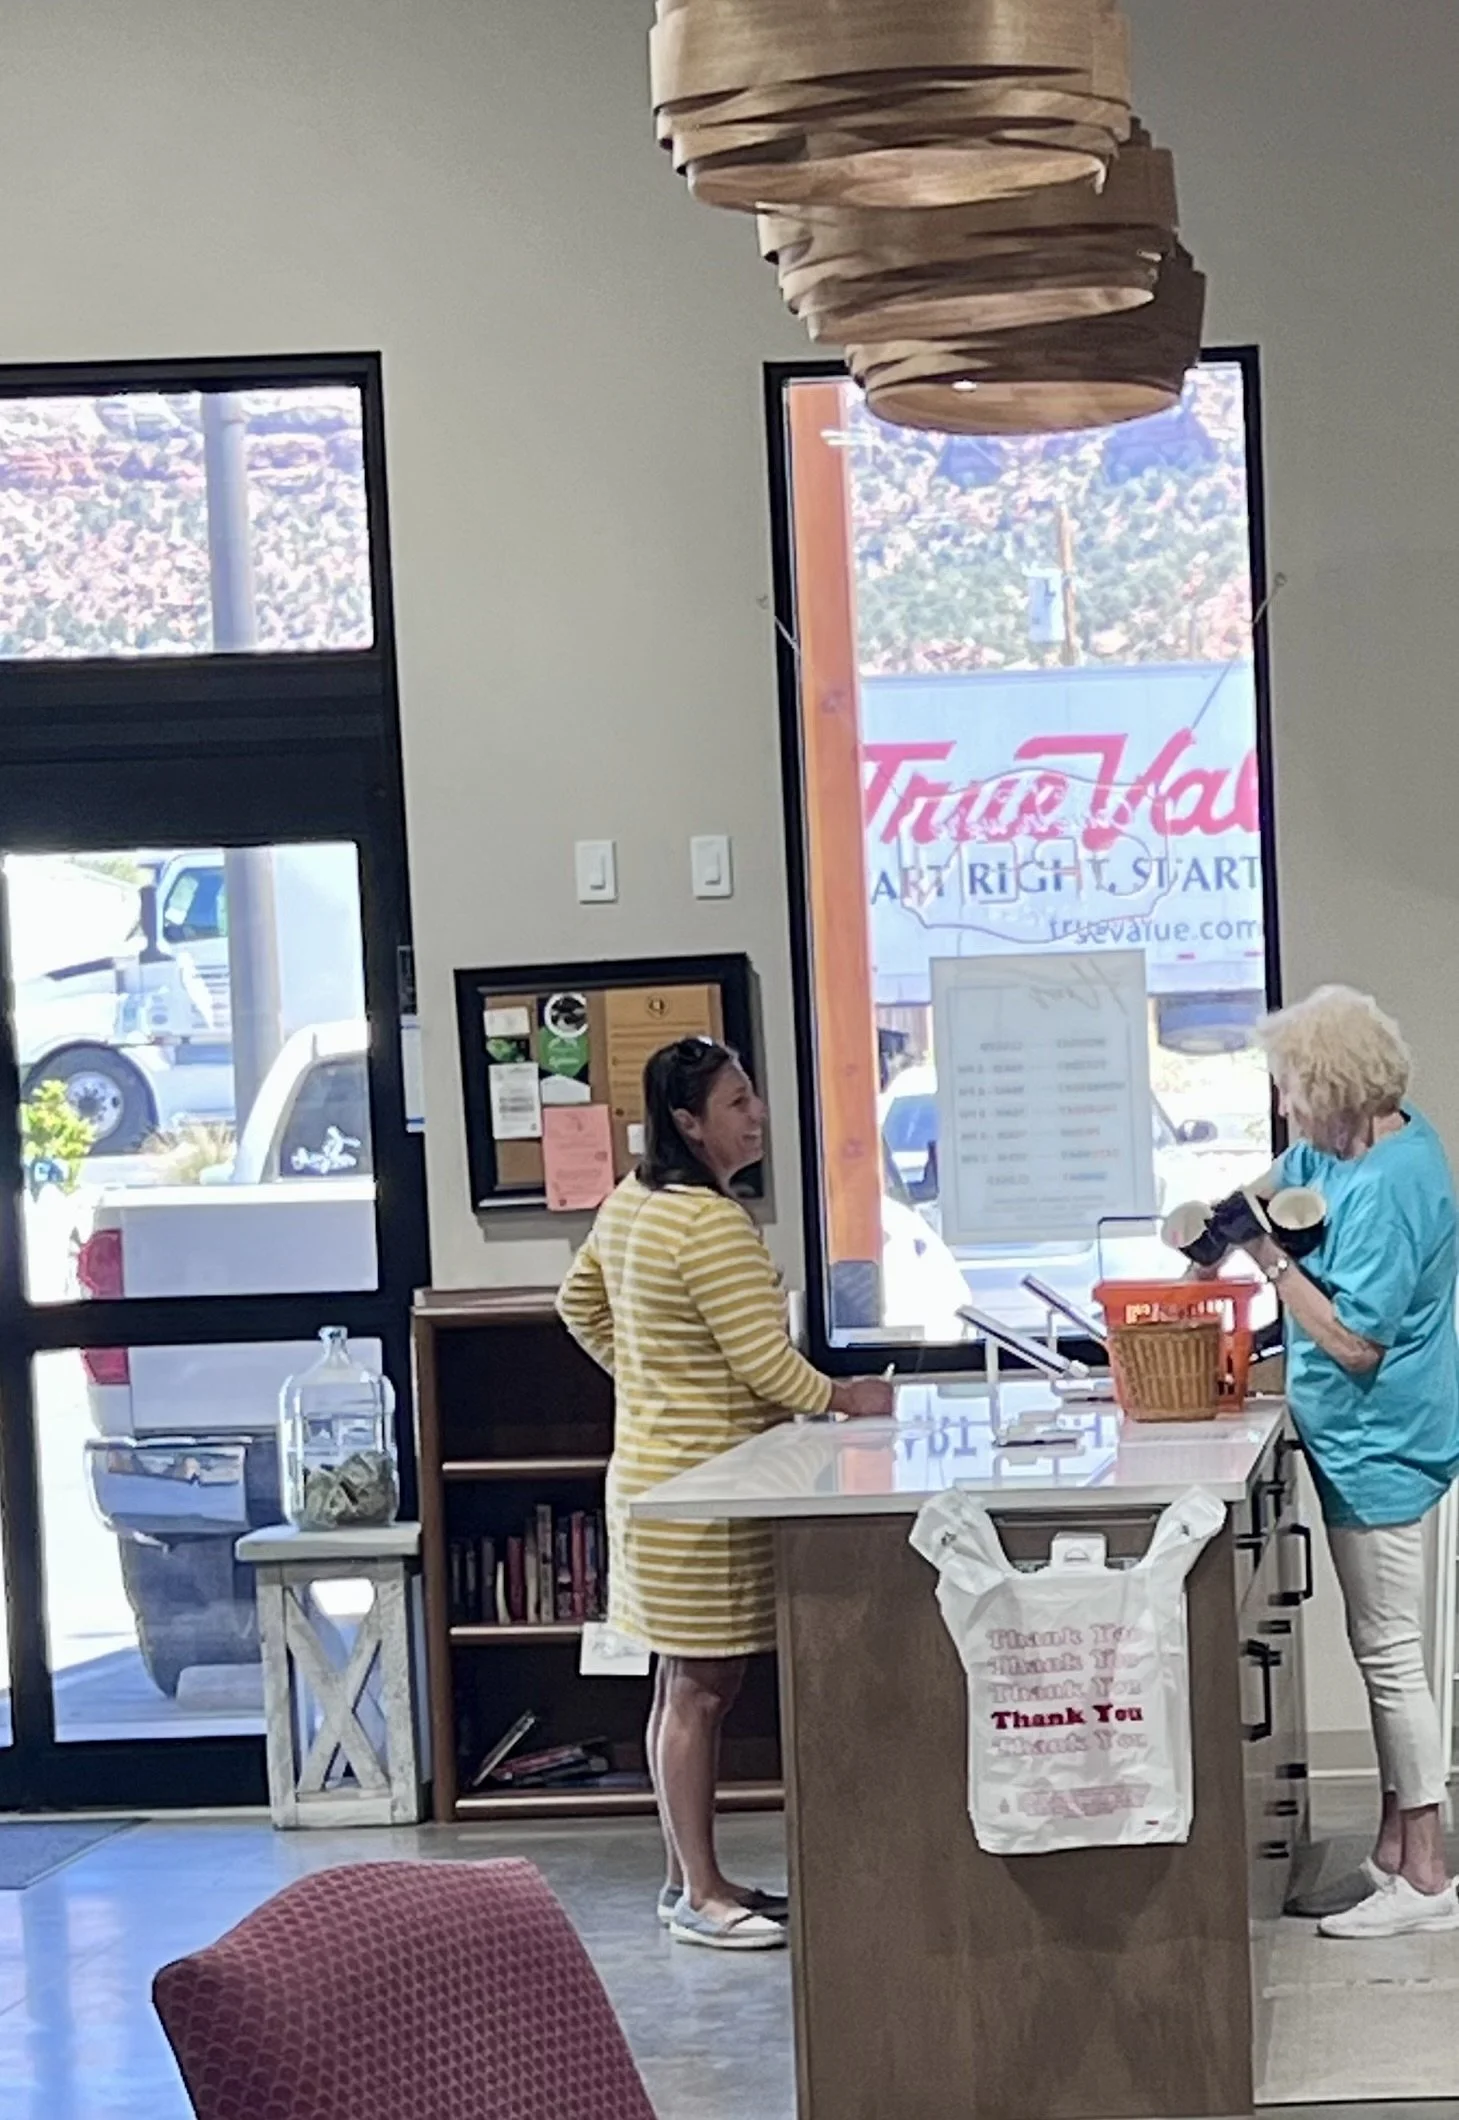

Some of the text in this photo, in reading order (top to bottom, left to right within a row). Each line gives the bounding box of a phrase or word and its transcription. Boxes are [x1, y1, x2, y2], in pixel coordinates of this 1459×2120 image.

[863, 740, 1069, 844] True
[990, 1702, 1144, 1730] Thank You
